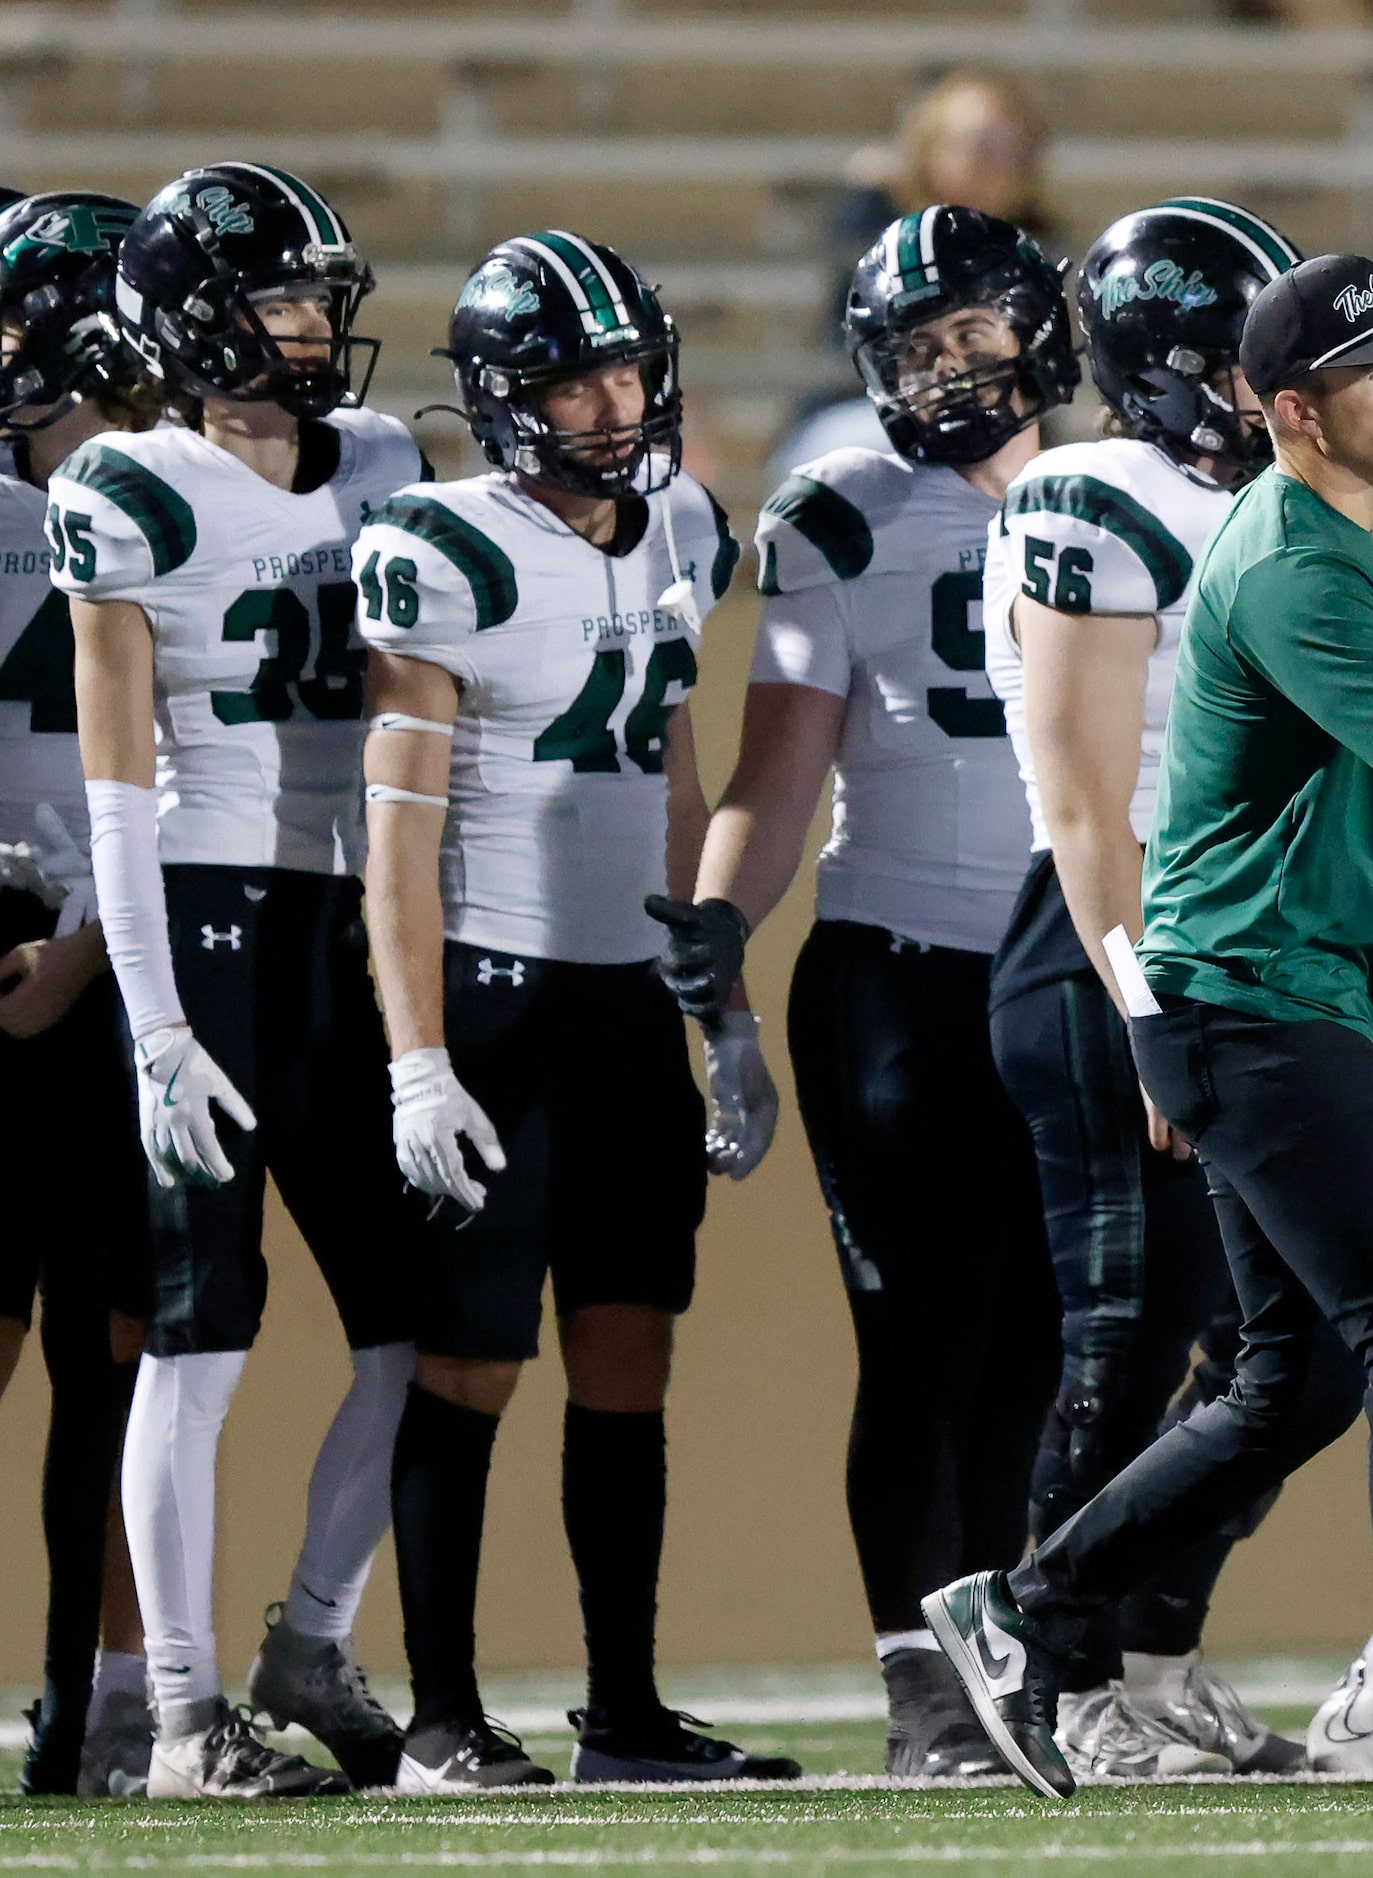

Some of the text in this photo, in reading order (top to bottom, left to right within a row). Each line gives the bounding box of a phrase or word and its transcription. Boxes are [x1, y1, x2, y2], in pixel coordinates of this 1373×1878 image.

[252, 550, 352, 582] PROSPE
[360, 549, 419, 630] 46
[1022, 535, 1094, 615] 56
[211, 581, 368, 727] 35
[533, 637, 698, 774] 46
